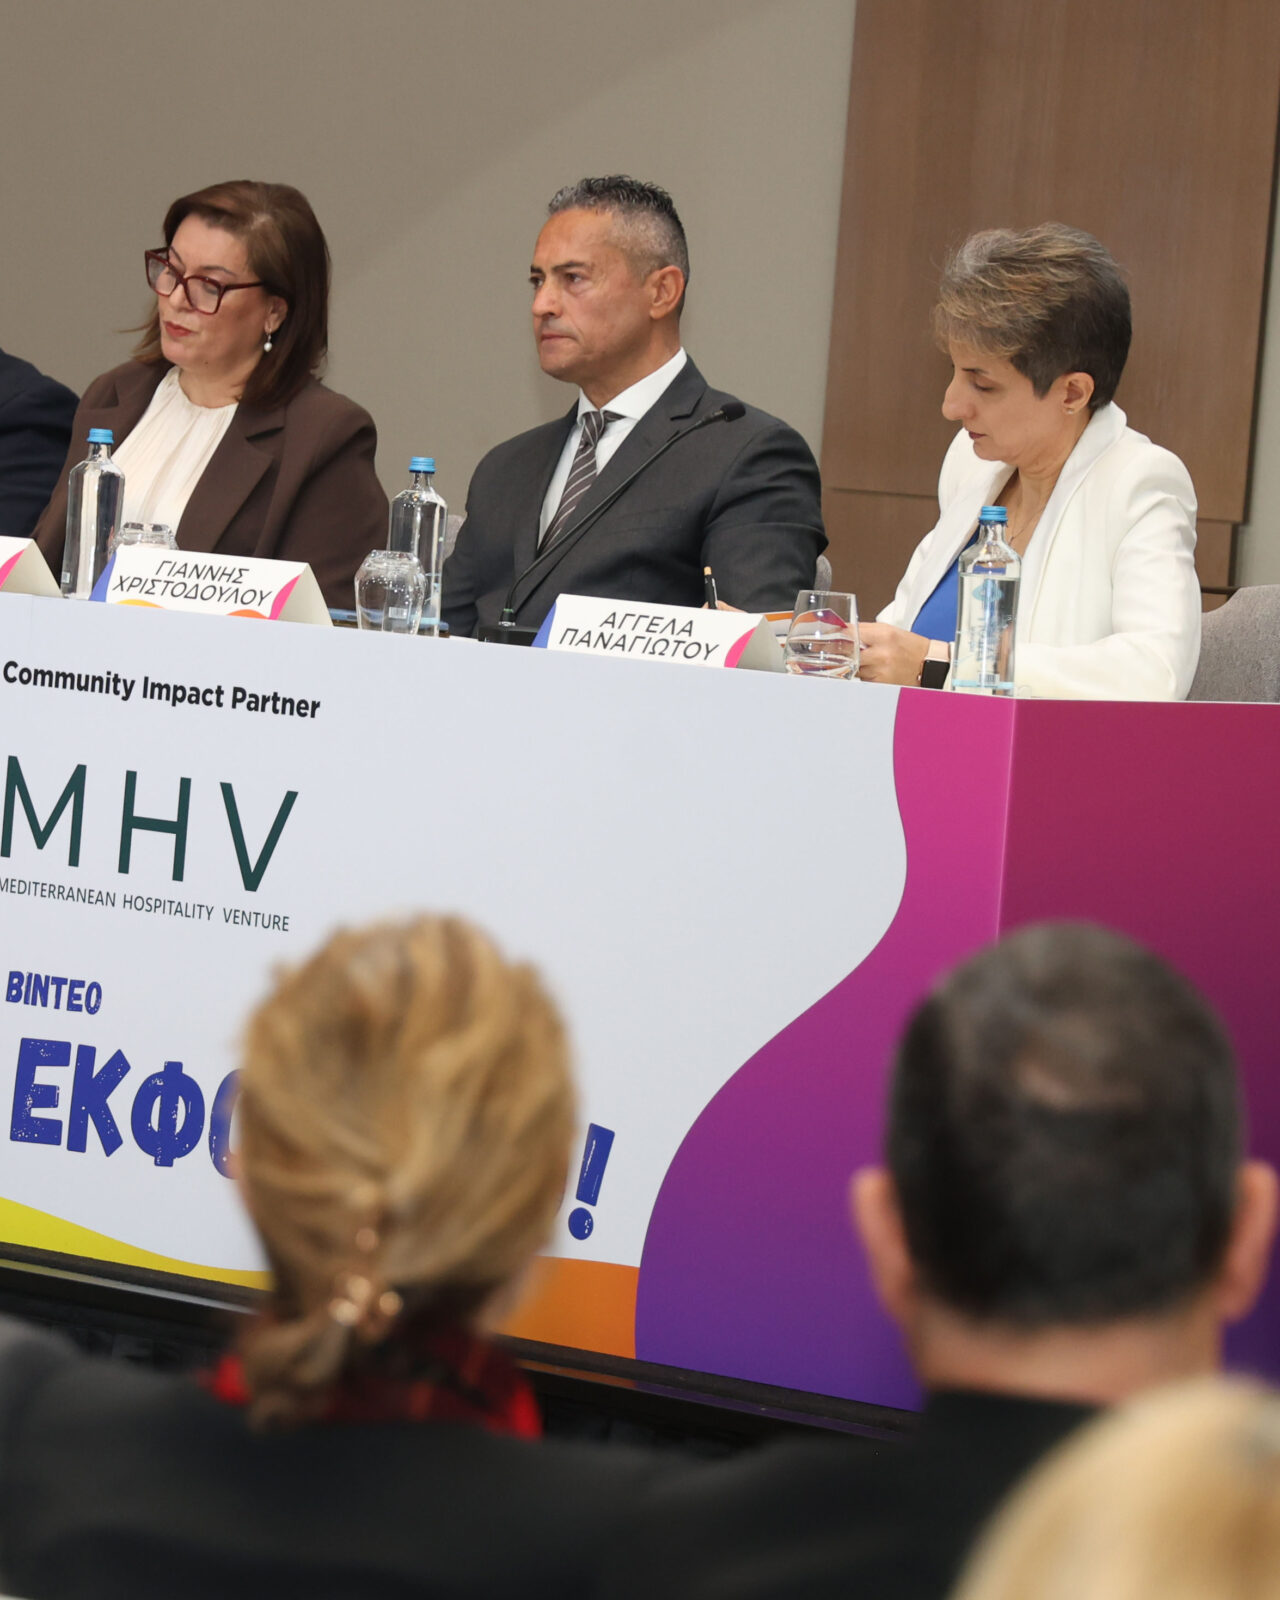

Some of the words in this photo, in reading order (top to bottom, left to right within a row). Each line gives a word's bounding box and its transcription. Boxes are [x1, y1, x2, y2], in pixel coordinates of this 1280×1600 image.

[112, 575, 273, 607] ΧΡΙΣΤΟΔΟΥΛΟΥ
[155, 560, 250, 584] ΓΙΑΝΝΗΣ
[599, 611, 694, 637] ΑΓΓΕΛΑ
[559, 628, 720, 661] ΠΑΝΑΓΙΩΤΟΥ
[2, 660, 136, 702] Community
[142, 676, 225, 708] Impact
[231, 686, 321, 719] Partner
[0, 755, 299, 893] MHV
[123, 893, 215, 921] HOSPITALITY
[222, 907, 290, 932] VENTURE
[5, 970, 103, 1015] ΒΙΝΤΕΟ
[10, 1037, 243, 1180] ΕΚΦΟ
